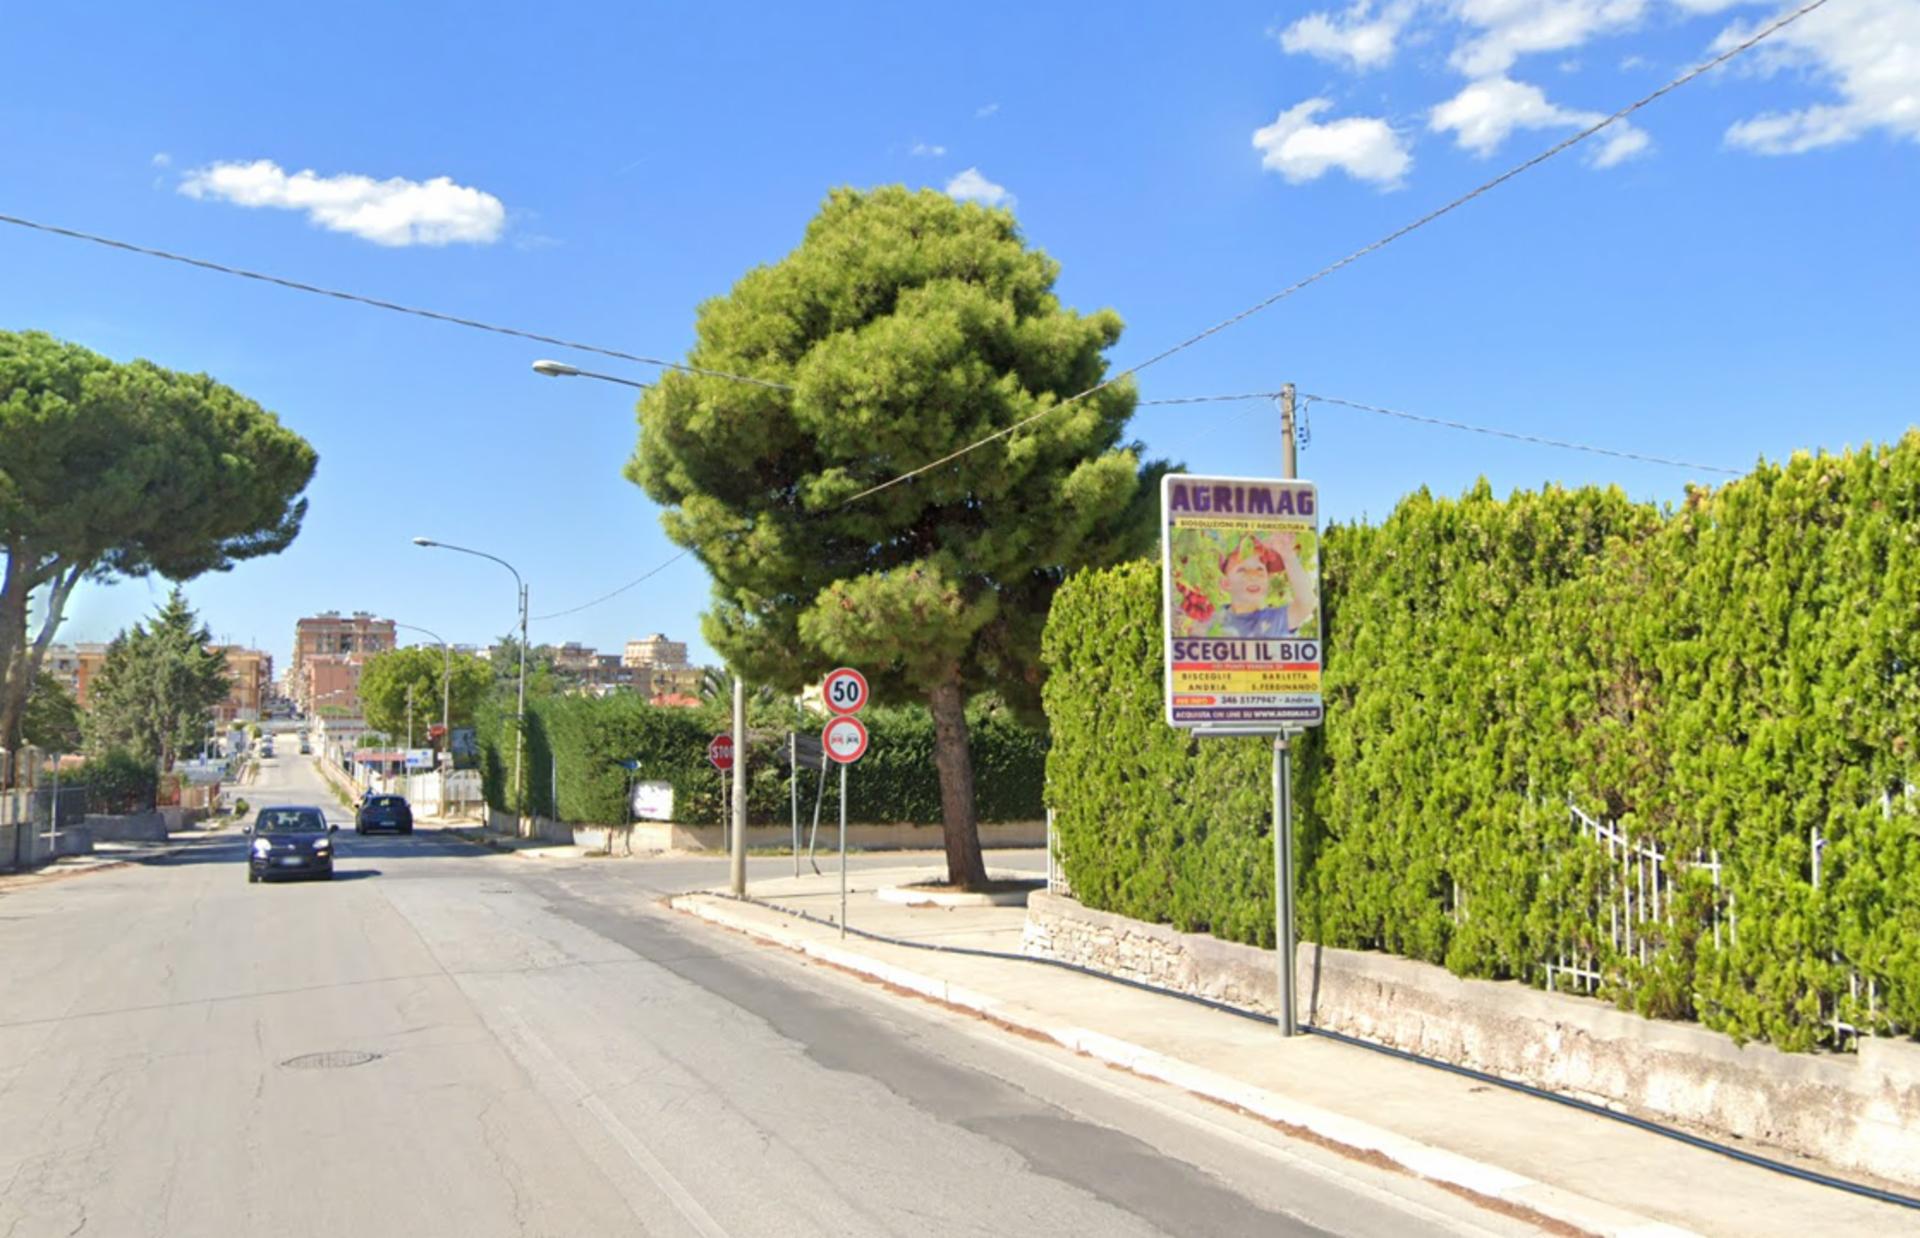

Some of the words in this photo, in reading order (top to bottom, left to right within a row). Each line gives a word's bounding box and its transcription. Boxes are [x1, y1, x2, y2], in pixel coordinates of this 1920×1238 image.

[1171, 484, 1314, 515] AGRIMAG
[1236, 521, 1249, 529] PER
[1174, 642, 1246, 661] SCEGLI
[1255, 643, 1272, 660] IL
[1280, 643, 1317, 661] BIO
[833, 681, 859, 702] 50
[1188, 683, 1227, 691] ANDRIA
